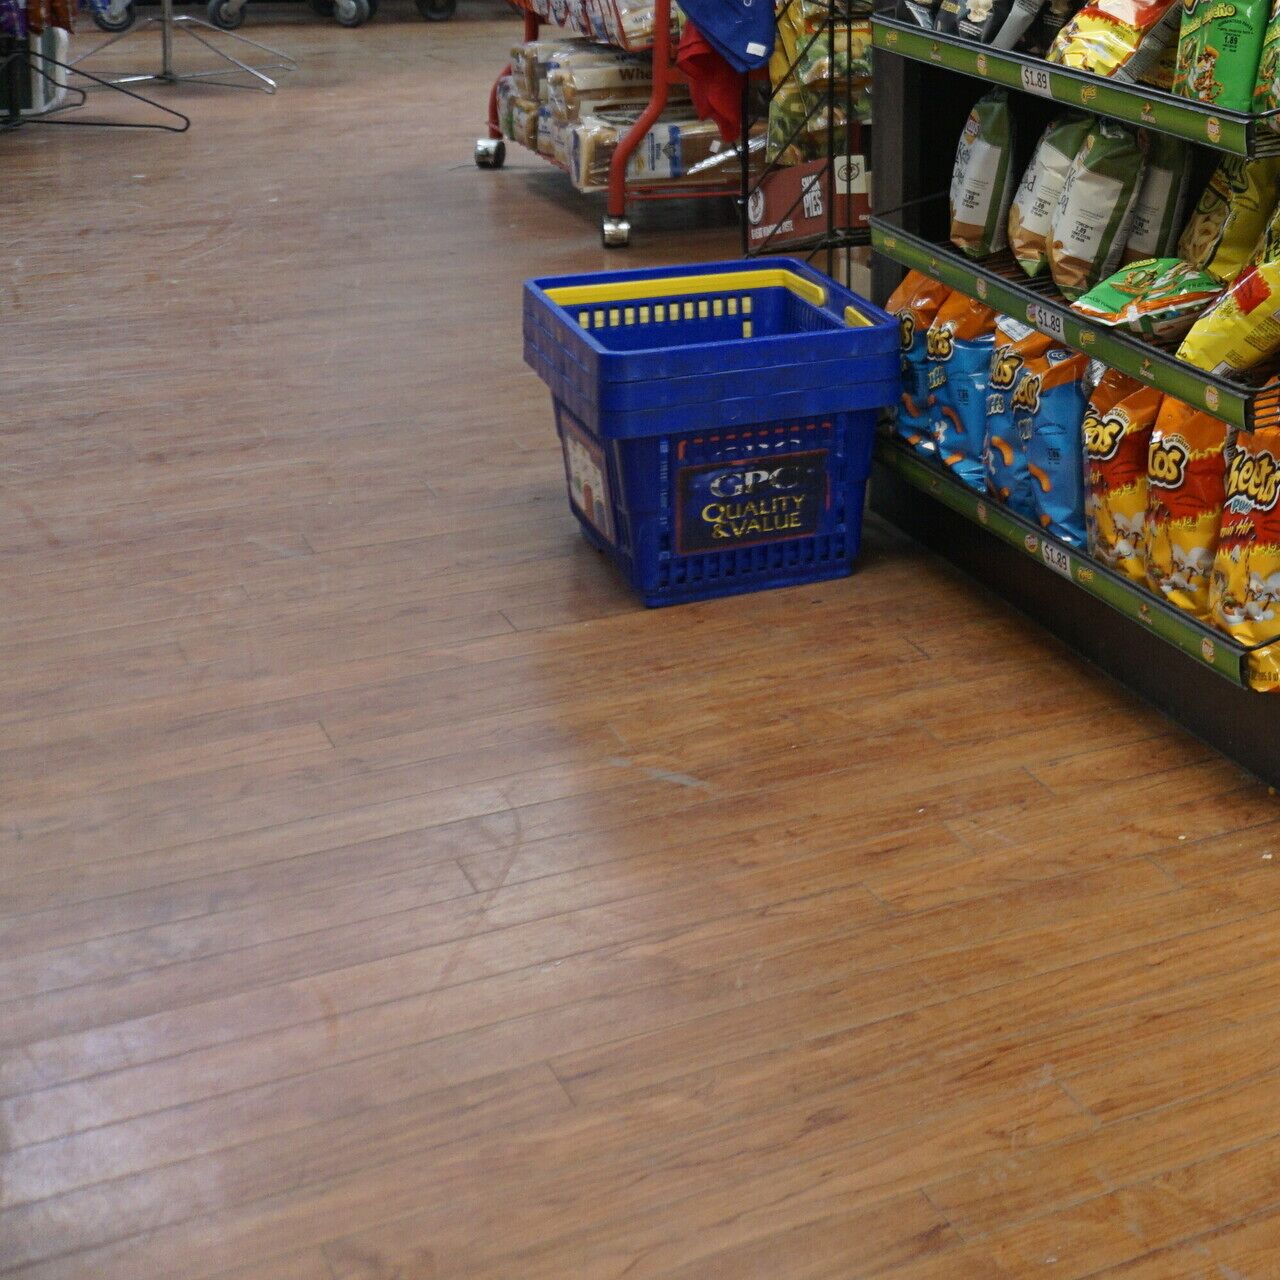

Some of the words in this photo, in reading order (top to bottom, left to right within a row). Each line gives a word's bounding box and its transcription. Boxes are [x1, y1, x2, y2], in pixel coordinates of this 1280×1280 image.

[1024, 68, 1049, 90] $1.89
[1036, 307, 1061, 333] $1.89
[709, 466, 800, 499] GPC
[702, 495, 806, 524] QUALITY
[729, 511, 802, 537] VALUE
[1041, 545, 1069, 572] $1.89
